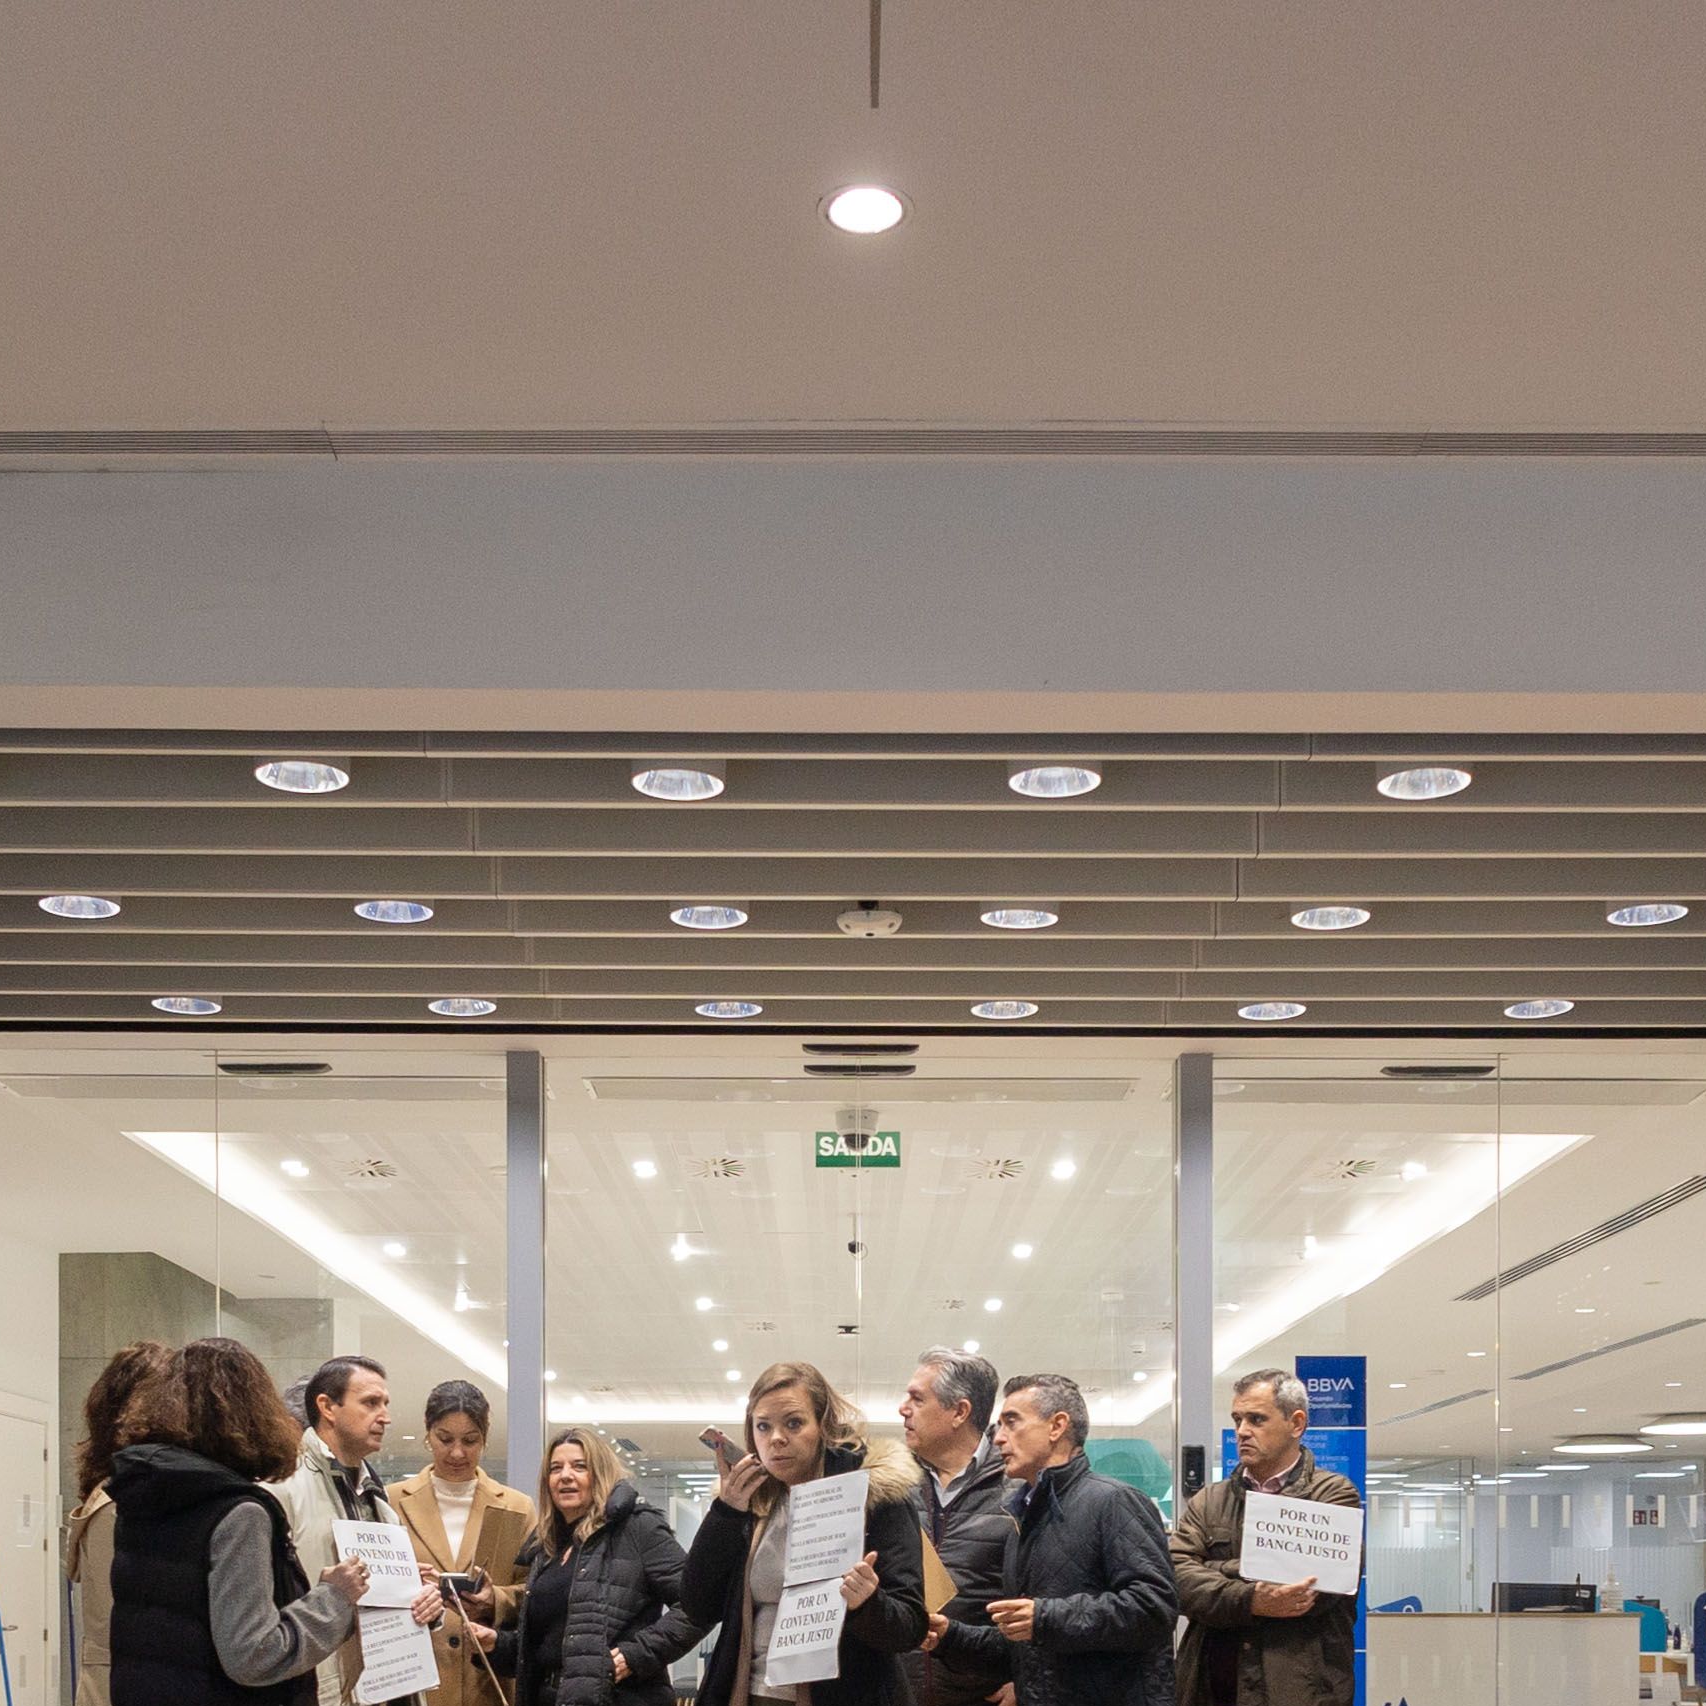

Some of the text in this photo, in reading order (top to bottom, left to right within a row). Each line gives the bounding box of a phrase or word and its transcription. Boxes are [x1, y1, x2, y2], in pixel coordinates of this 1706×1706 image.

[818, 1135, 898, 1157] SADA
[1307, 1376, 1355, 1392] BBVA
[1280, 1508, 1331, 1526] POR UN
[357, 1532, 391, 1545] POR UN
[1256, 1520, 1352, 1546] CONVENIO DE
[396, 1551, 409, 1562] DE
[1256, 1536, 1348, 1562] BANCA JUSTO
[385, 1564, 413, 1577] JUSTO
[797, 1592, 830, 1610] POR UN
[780, 1608, 840, 1631] CONVENIO DE
[776, 1627, 834, 1649] BANCA JUSTO
